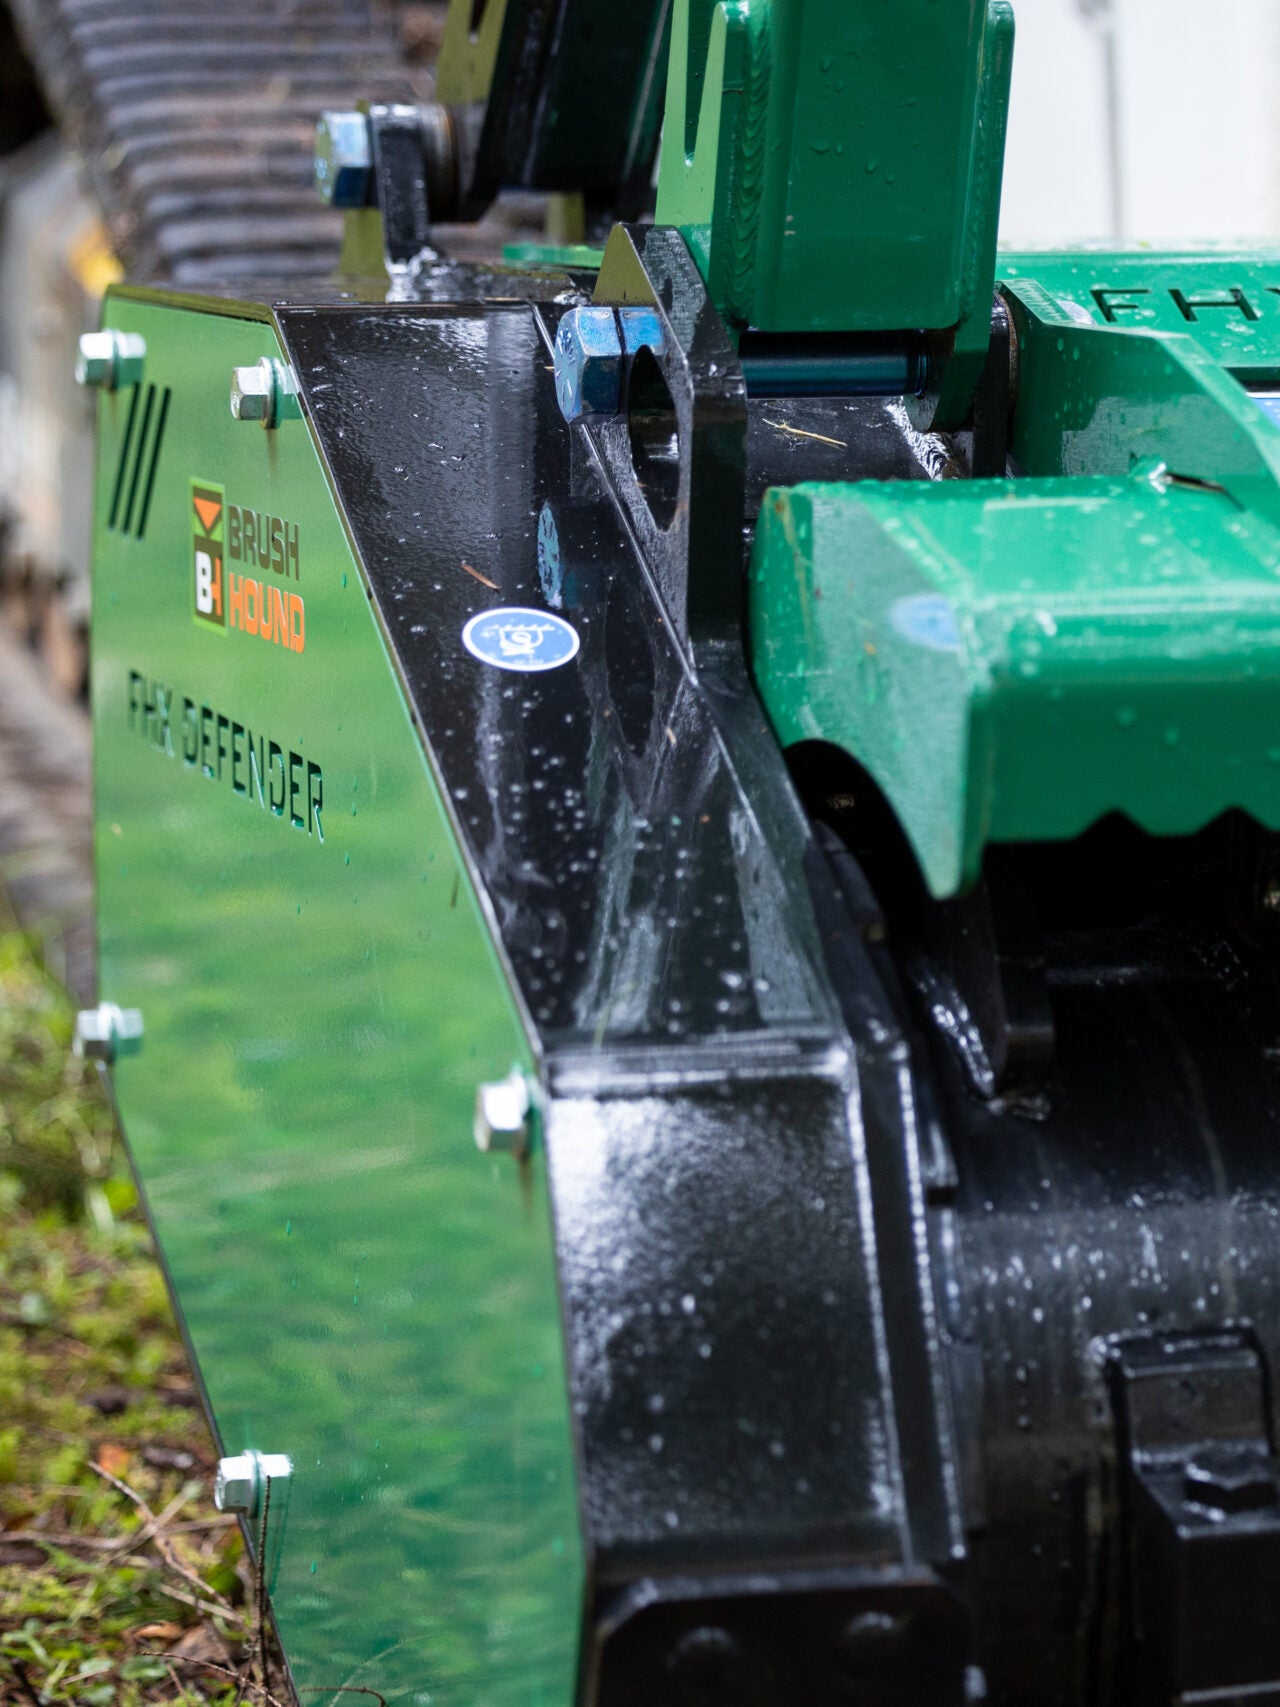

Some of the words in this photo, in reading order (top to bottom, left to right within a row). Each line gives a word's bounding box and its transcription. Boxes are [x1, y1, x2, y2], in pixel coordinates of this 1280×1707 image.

[228, 505, 299, 581] BRUSH
[229, 572, 305, 654] HOUND
[128, 667, 175, 758] FHX
[183, 696, 325, 843] DEFENDER
